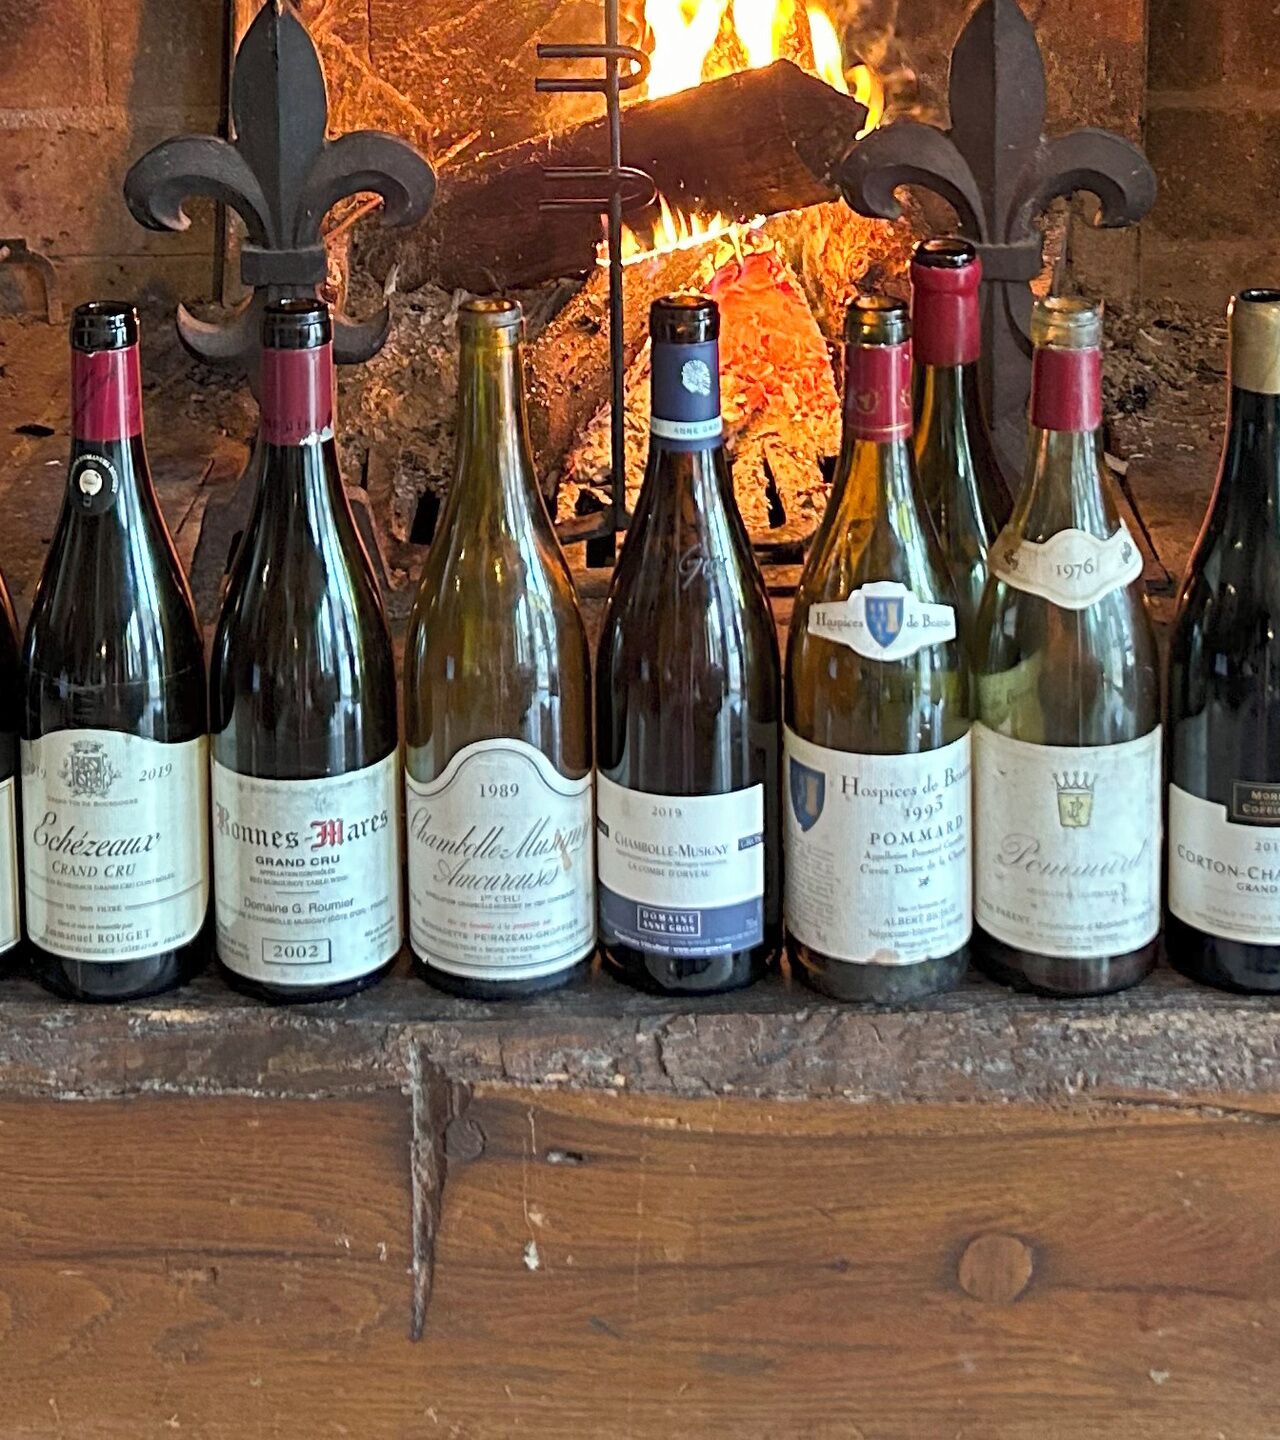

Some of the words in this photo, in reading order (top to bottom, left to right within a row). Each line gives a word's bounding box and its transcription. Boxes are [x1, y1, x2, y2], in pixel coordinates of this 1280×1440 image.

[1056, 559, 1095, 578] 1976
[138, 763, 174, 782] 2019
[479, 783, 520, 798] 1989
[841, 775, 918, 805] Hospices
[922, 774, 939, 794] de
[651, 806, 683, 818] 2019
[870, 814, 963, 847] POMMARD
[615, 830, 730, 858] CHAMBOLLE-MUSIGNY
[52, 860, 98, 878] GRAND
[104, 862, 137, 879] CRU
[255, 855, 306, 868] GRAND
[309, 854, 341, 866] CRU
[433, 859, 559, 891] Amoureuses
[1236, 883, 1278, 894] GRAND
[243, 897, 289, 914] Domaine
[291, 903, 304, 914] G.
[308, 897, 355, 914] Roumier
[642, 910, 695, 924] DOMAINE
[97, 928, 151, 944] ROUGET
[272, 945, 320, 959] 2002
